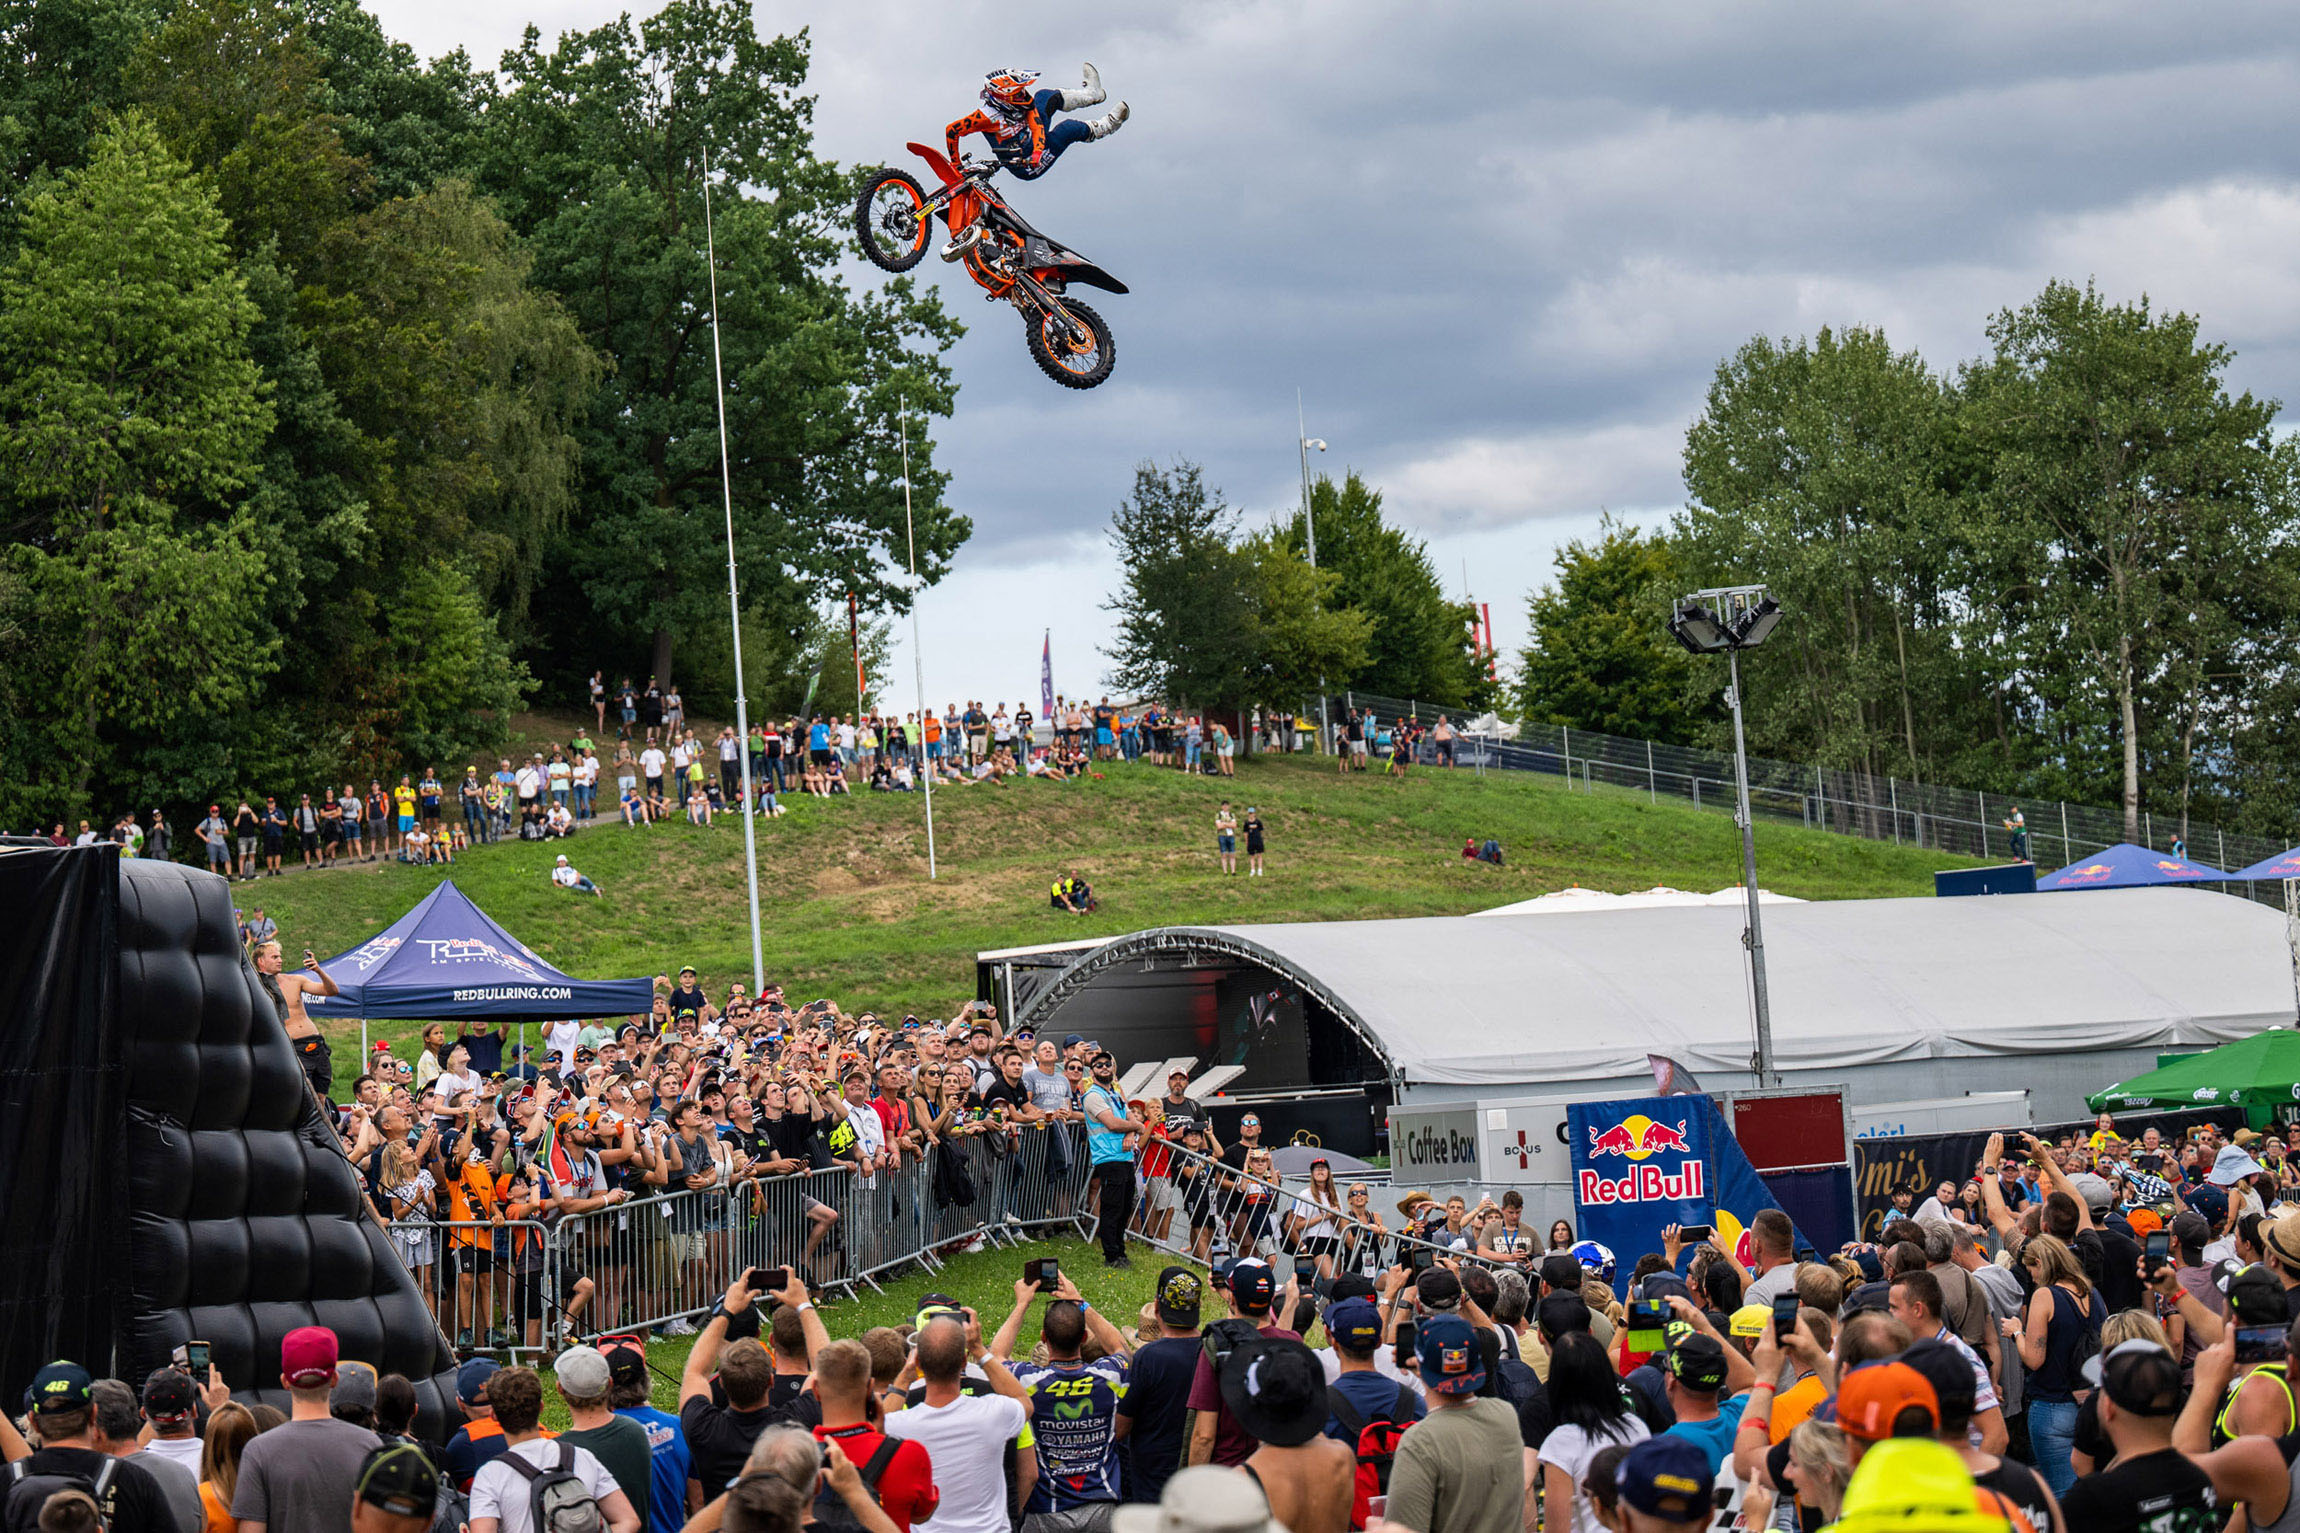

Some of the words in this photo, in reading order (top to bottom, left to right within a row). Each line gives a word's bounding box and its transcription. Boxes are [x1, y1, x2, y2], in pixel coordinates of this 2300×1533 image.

[453, 987, 571, 1001] REDBULLRING.COM
[1737, 1104, 1751, 1112] 260
[1408, 1125, 1448, 1165] Coffee
[1450, 1129, 1476, 1164] Box
[1579, 1164, 1639, 1206] Red
[1640, 1160, 1704, 1202] Bull
[44, 1380, 70, 1392] 46
[1045, 1376, 1094, 1397] 46
[1040, 1417, 1106, 1430] movistar
[1057, 1431, 1106, 1444] YAMAHA
